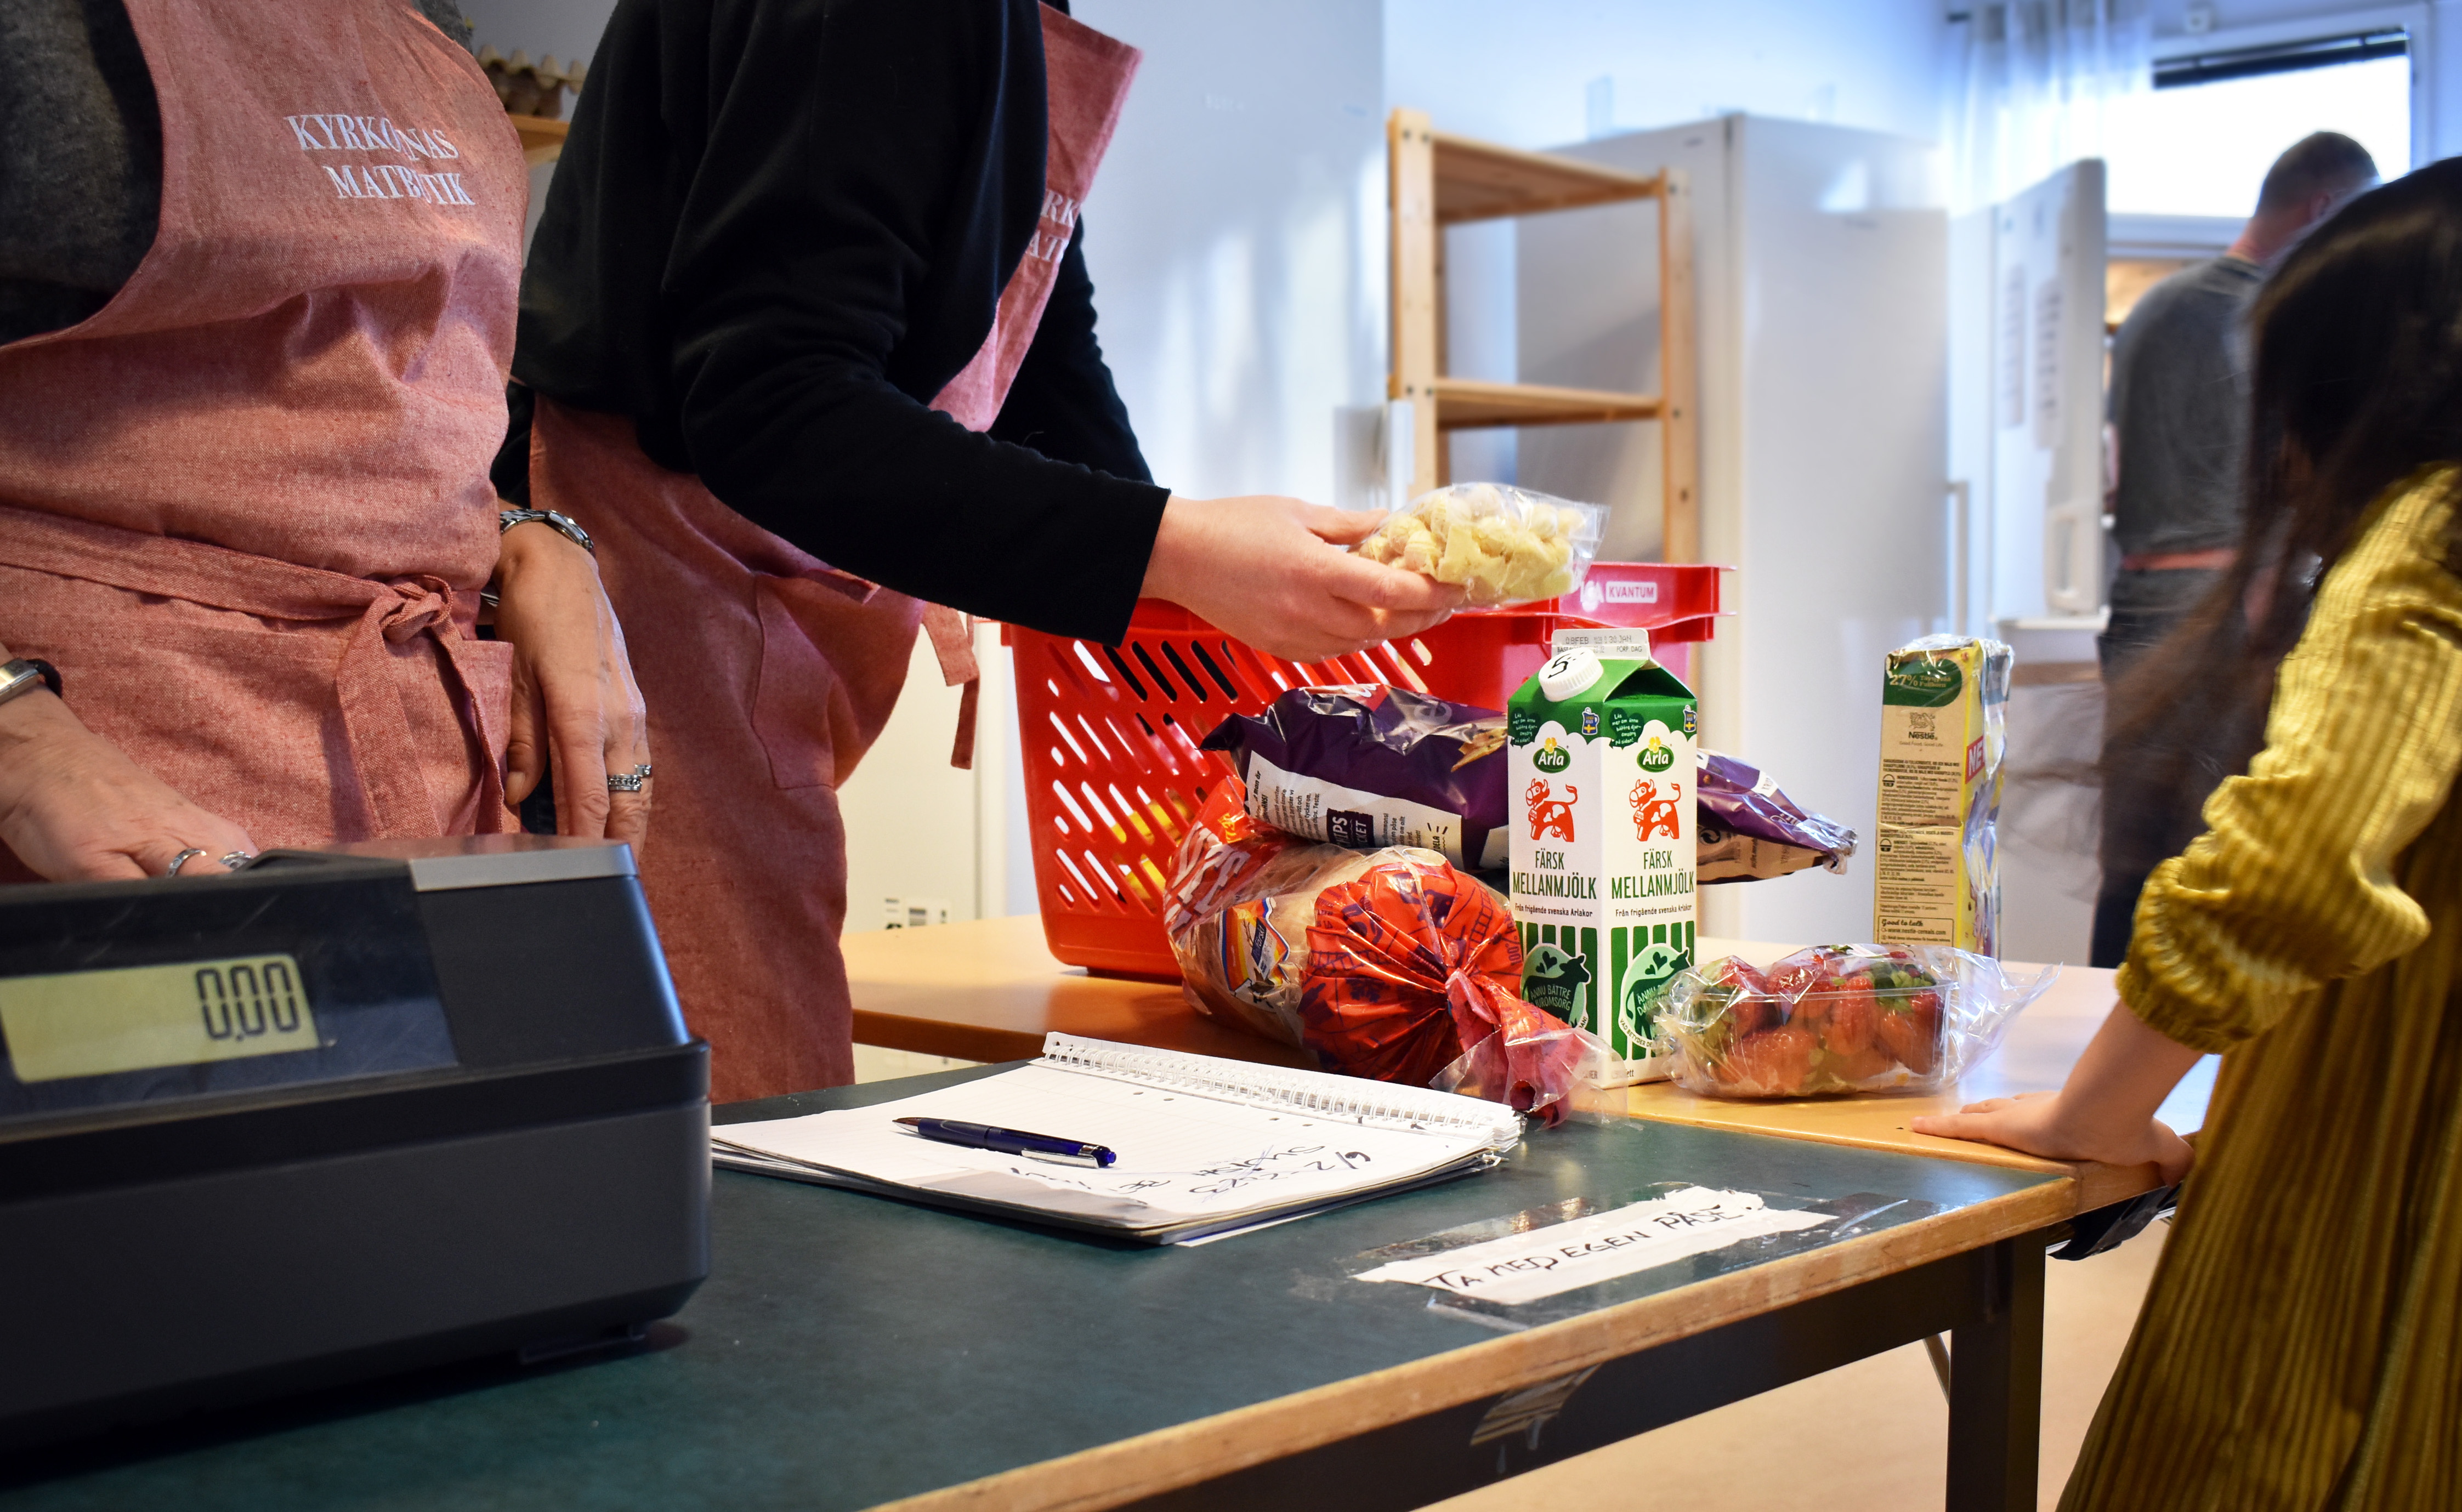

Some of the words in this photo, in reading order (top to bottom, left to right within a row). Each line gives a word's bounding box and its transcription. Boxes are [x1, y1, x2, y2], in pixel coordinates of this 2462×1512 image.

[284, 114, 460, 161] KYRKONAS
[322, 166, 476, 205] MATBUTIK
[1609, 584, 1655, 598] KVANTUM
[1538, 752, 1564, 766] Arla
[1642, 752, 1669, 765] Arla
[1432, 836, 1440, 849] DELA
[1535, 848, 1564, 870] FÄRSK
[1643, 848, 1672, 869] FÄRSK
[1513, 872, 1597, 900] MELLANMJÖLK
[1612, 868, 1694, 899] MELLANMJÖLK
[1524, 905, 1547, 914] frigående
[1547, 907, 1569, 916] svenska
[1570, 908, 1593, 917] Arlakor
[1615, 908, 1629, 917] Från
[1630, 905, 1657, 917] frigående
[1658, 906, 1677, 914] svenska
[196, 962, 300, 1041] 0.00
[1627, 1028, 1646, 1045] BETYDER
[1424, 1270, 1483, 1288] TA
[1486, 1256, 1558, 1277] MED
[1559, 1230, 1652, 1259] EGEN
